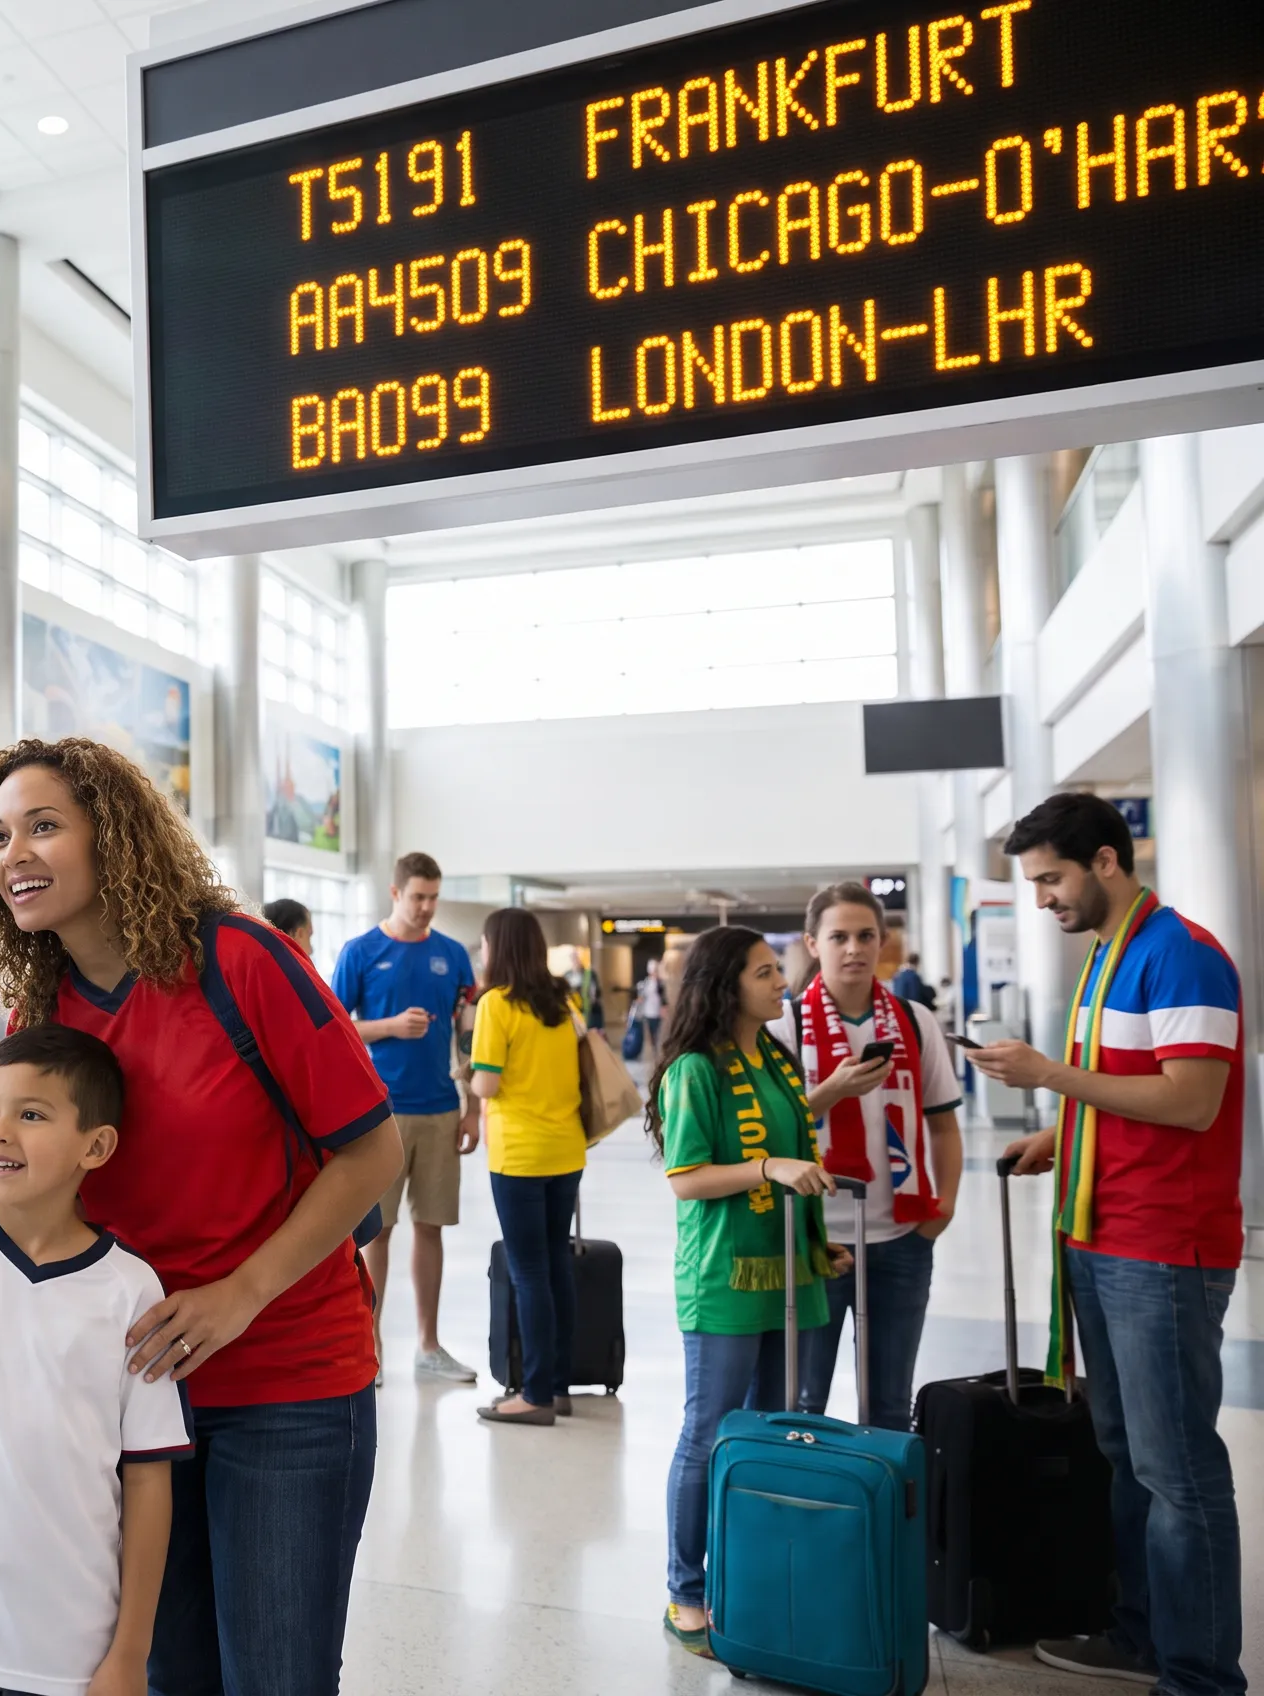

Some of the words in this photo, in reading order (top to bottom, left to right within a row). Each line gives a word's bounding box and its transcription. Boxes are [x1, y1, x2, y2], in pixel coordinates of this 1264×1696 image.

[585, 0, 1033, 181] FRANKFURT
[287, 129, 477, 243] T5191
[586, 89, 1264, 302] CHICAGO-O'HAR
[288, 237, 533, 357] AA4509
[589, 261, 1095, 424] LONDON-LHR
[290, 364, 492, 472] BA099
